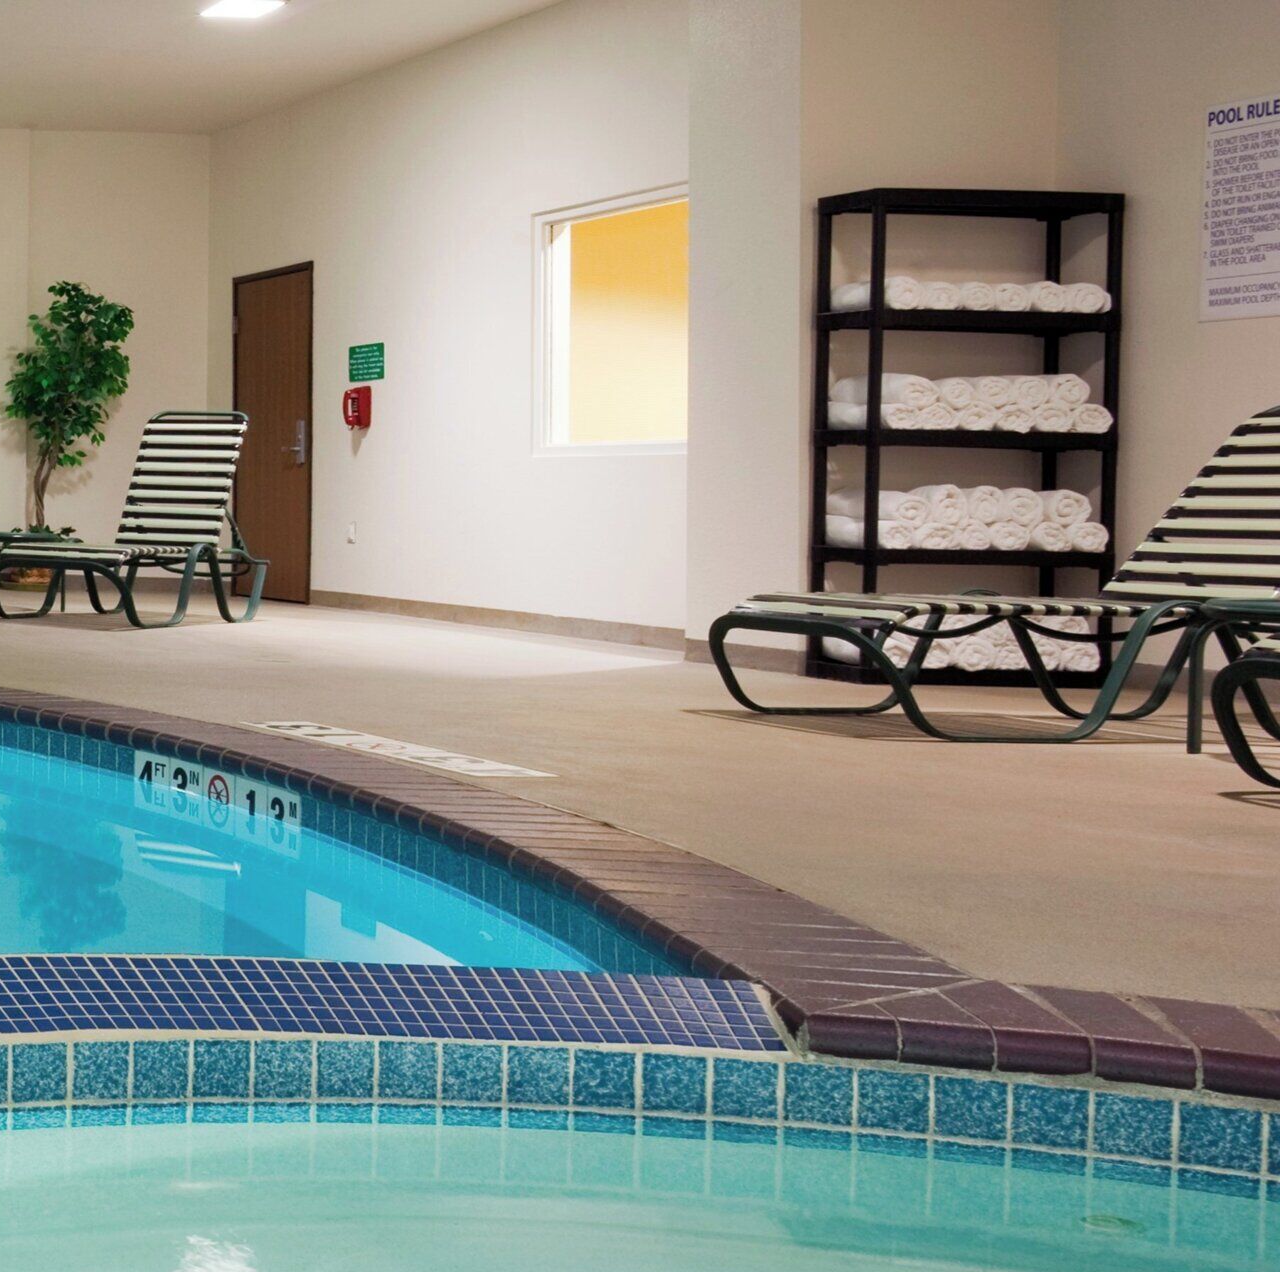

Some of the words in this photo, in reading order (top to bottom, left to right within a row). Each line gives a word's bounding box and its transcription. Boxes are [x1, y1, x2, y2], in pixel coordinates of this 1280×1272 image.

[1208, 107, 1243, 127] POOL
[155, 763, 166, 778] FT
[189, 770, 200, 786] IN
